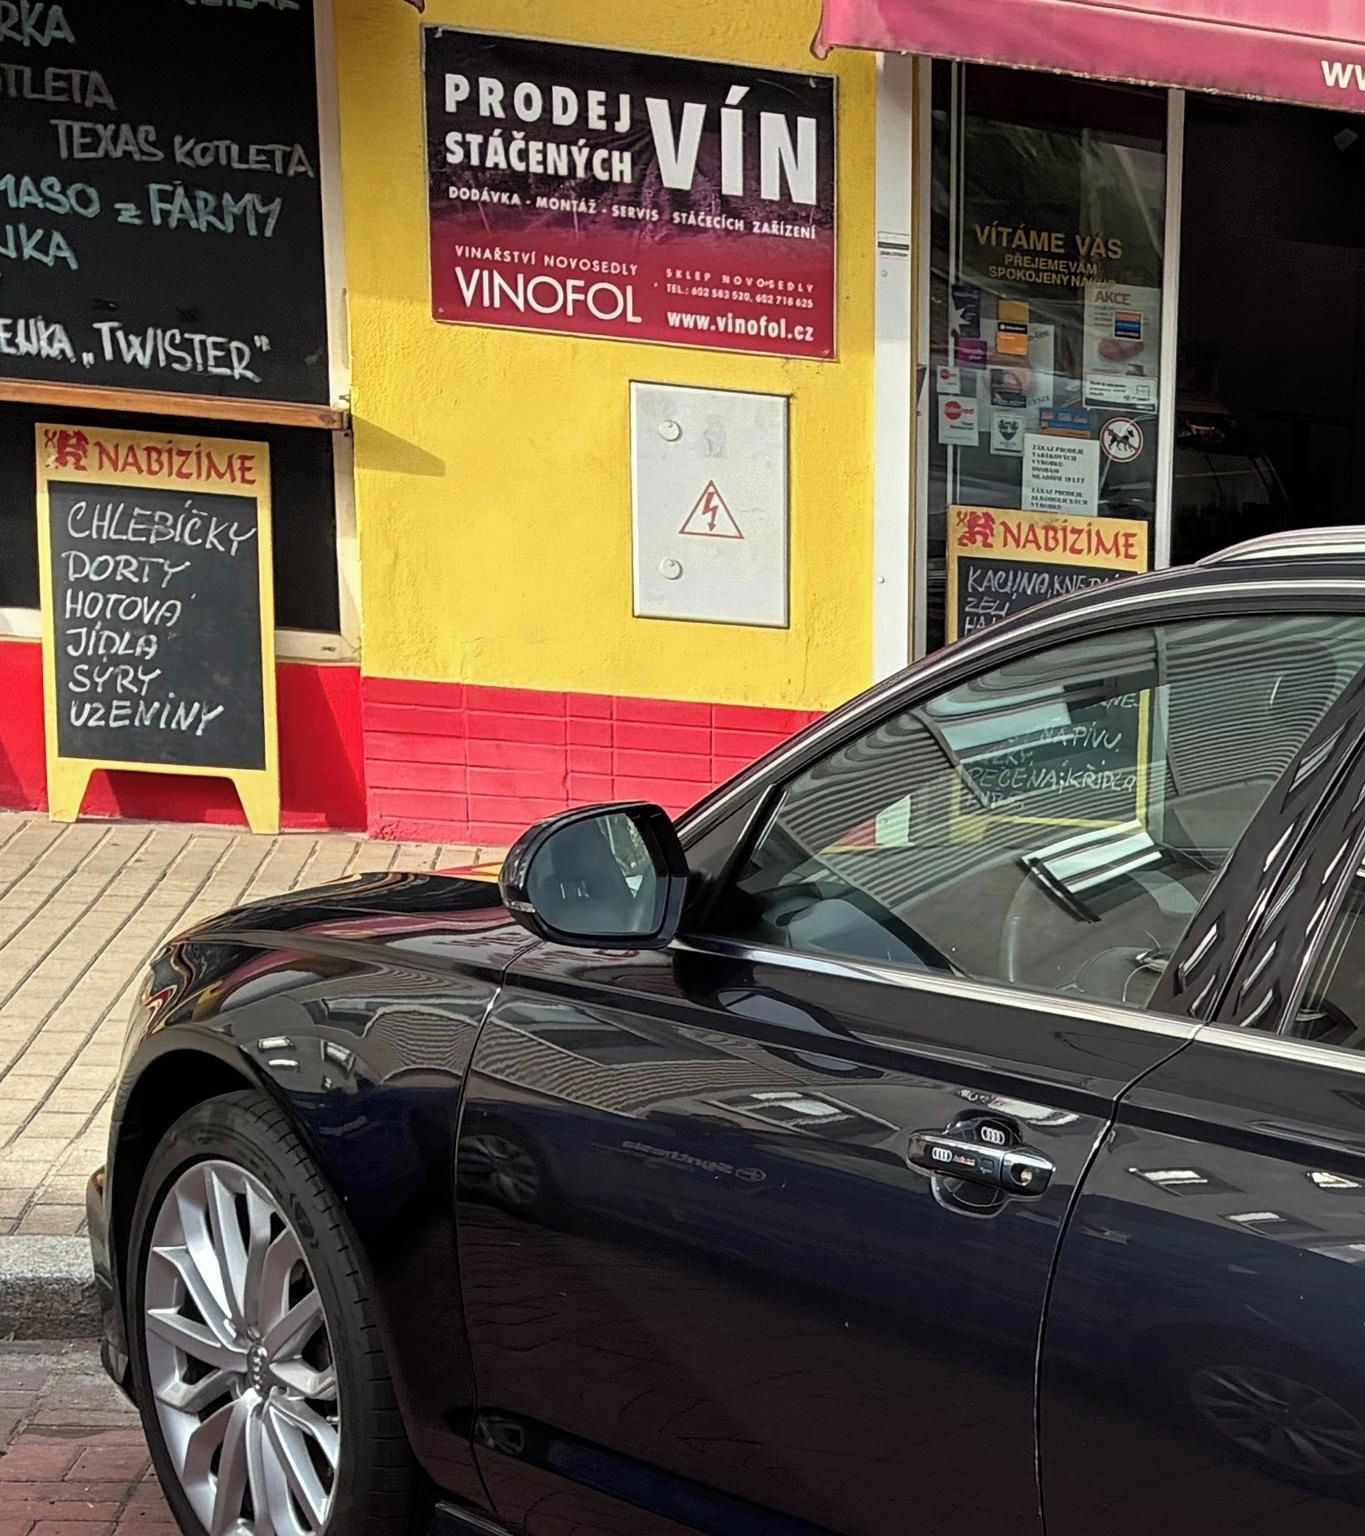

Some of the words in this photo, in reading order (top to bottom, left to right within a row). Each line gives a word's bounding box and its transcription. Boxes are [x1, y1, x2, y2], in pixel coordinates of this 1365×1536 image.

[50, 119, 164, 161] TEXAS
[173, 135, 314, 178] KOTLETA
[445, 73, 631, 133] PRODEJ
[645, 85, 817, 206] VÍN
[445, 130, 632, 184] STÁČENÝCH
[448, 186, 521, 206] DODÁVKA
[536, 196, 598, 214] MONTÁŽ
[611, 205, 659, 222] SERVIS
[672, 209, 745, 231] STÁČECÍCH
[752, 218, 817, 240] ZAŘÍZENÍ
[975, 220, 1066, 254] VÍTÁME
[1075, 231, 1124, 259] VÁS
[455, 245, 536, 265] VINAŘSTVÍ
[544, 255, 638, 276] NOVOSEDLY
[666, 268, 711, 282] SKLEP
[722, 275, 814, 293] NOVOSEDLY
[454, 266, 642, 324] VINOFOL
[666, 283, 689, 295] TEL.:
[1095, 290, 1131, 305] AKCE
[667, 311, 814, 342] www.vinofol.cz
[94, 440, 256, 486] NABÍZÍME
[67, 499, 256, 556] CHLEBÍČKY
[1000, 519, 1138, 560] NABÍZÍME
[61, 551, 191, 588] DORTY
[65, 621, 159, 659] JÍDLA
[68, 657, 162, 697] SÝRY
[70, 692, 225, 737] UZENINY
